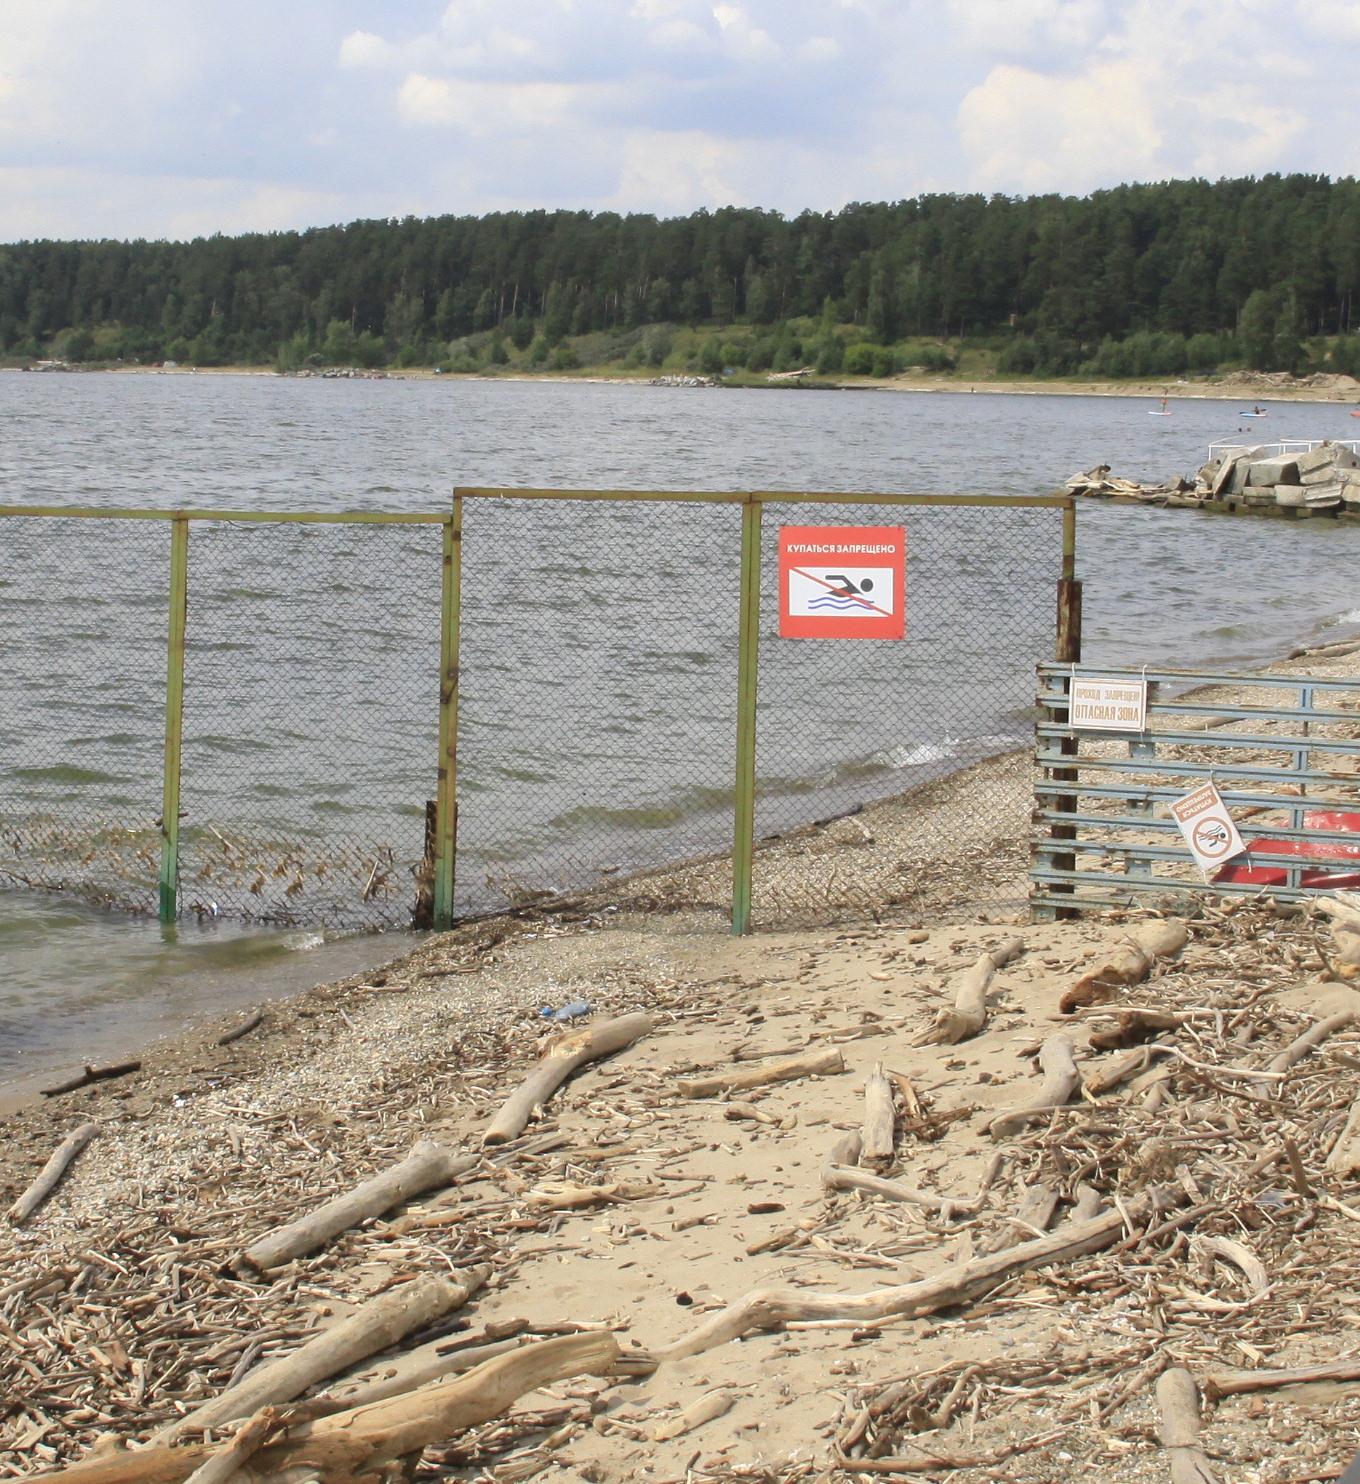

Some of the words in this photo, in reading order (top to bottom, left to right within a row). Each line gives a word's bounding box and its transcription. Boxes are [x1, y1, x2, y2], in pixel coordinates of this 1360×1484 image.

[787, 544, 835, 553] КУПАТЬСЯ
[837, 544, 895, 554] ЗАПРЕЩЕНО
[1075, 704, 1115, 720] ОПАСНАЯ
[1118, 706, 1139, 721] ЗОНА
[1182, 798, 1213, 818] КУПАТЬСЯ
